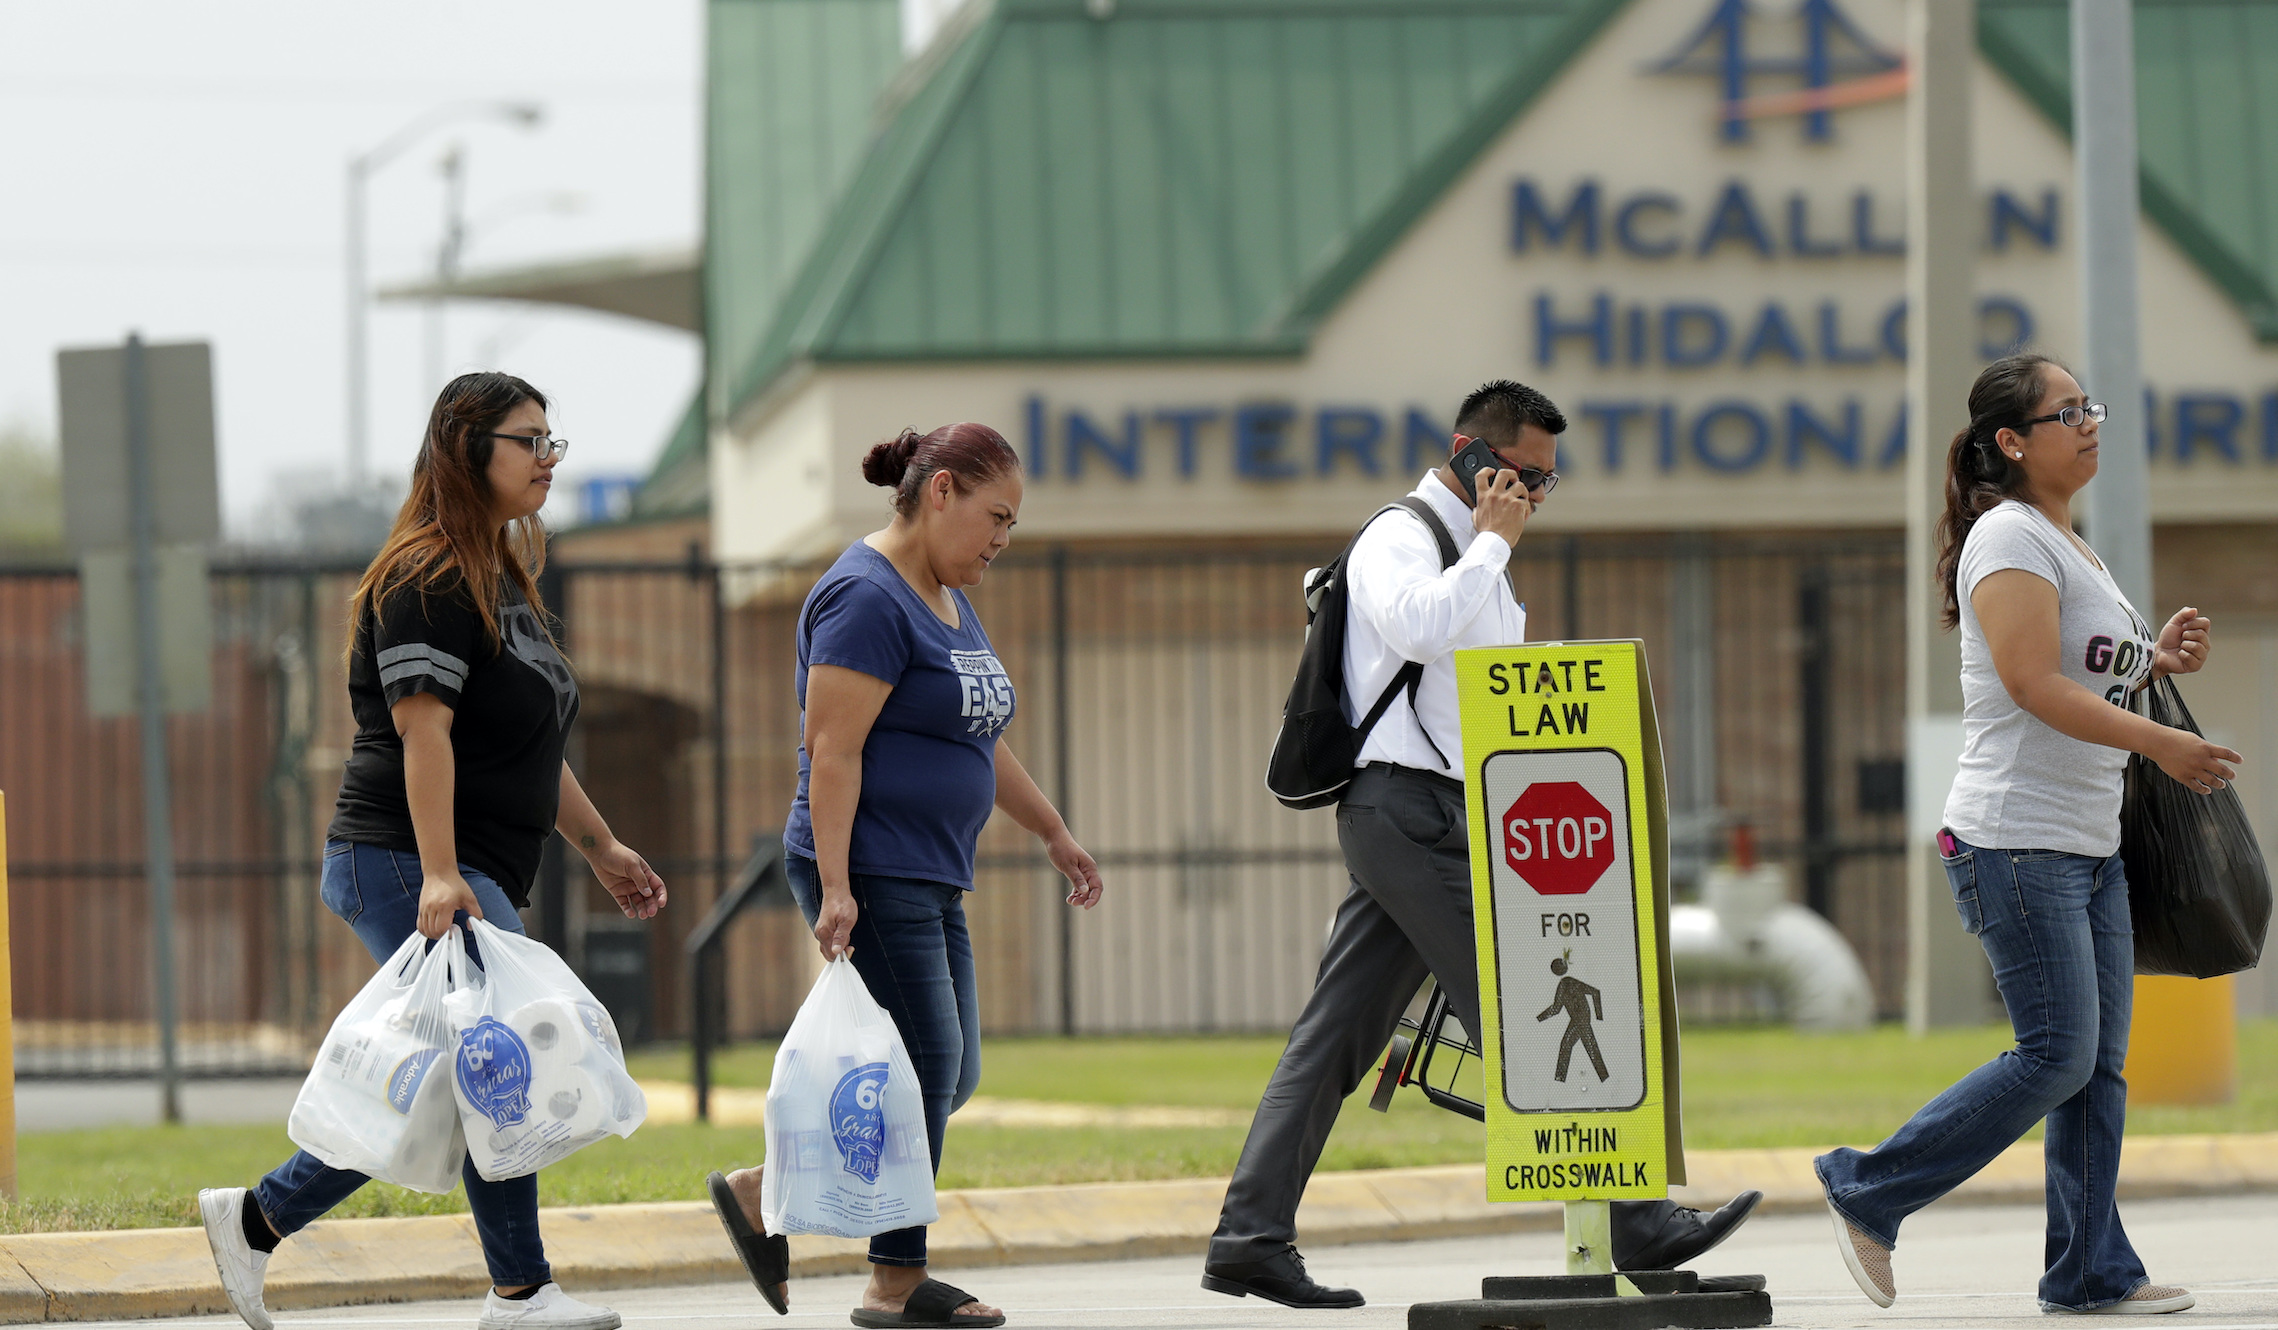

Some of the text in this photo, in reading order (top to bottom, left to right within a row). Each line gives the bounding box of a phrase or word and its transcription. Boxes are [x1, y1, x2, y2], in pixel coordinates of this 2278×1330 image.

[1511, 178, 2060, 258] MCALLN
[1489, 659, 1606, 695] STATE
[1508, 702, 1589, 737] LAW
[1508, 816, 1608, 861] STOP
[1541, 913, 1592, 938] FOR
[393, 1060, 420, 1105] Adorable
[489, 1089, 529, 1130] LOPEZ
[1535, 1127, 1617, 1154] WITHIN
[1505, 1162, 1648, 1190] CROSSWALK
[785, 1213, 807, 1229] BOLSA
